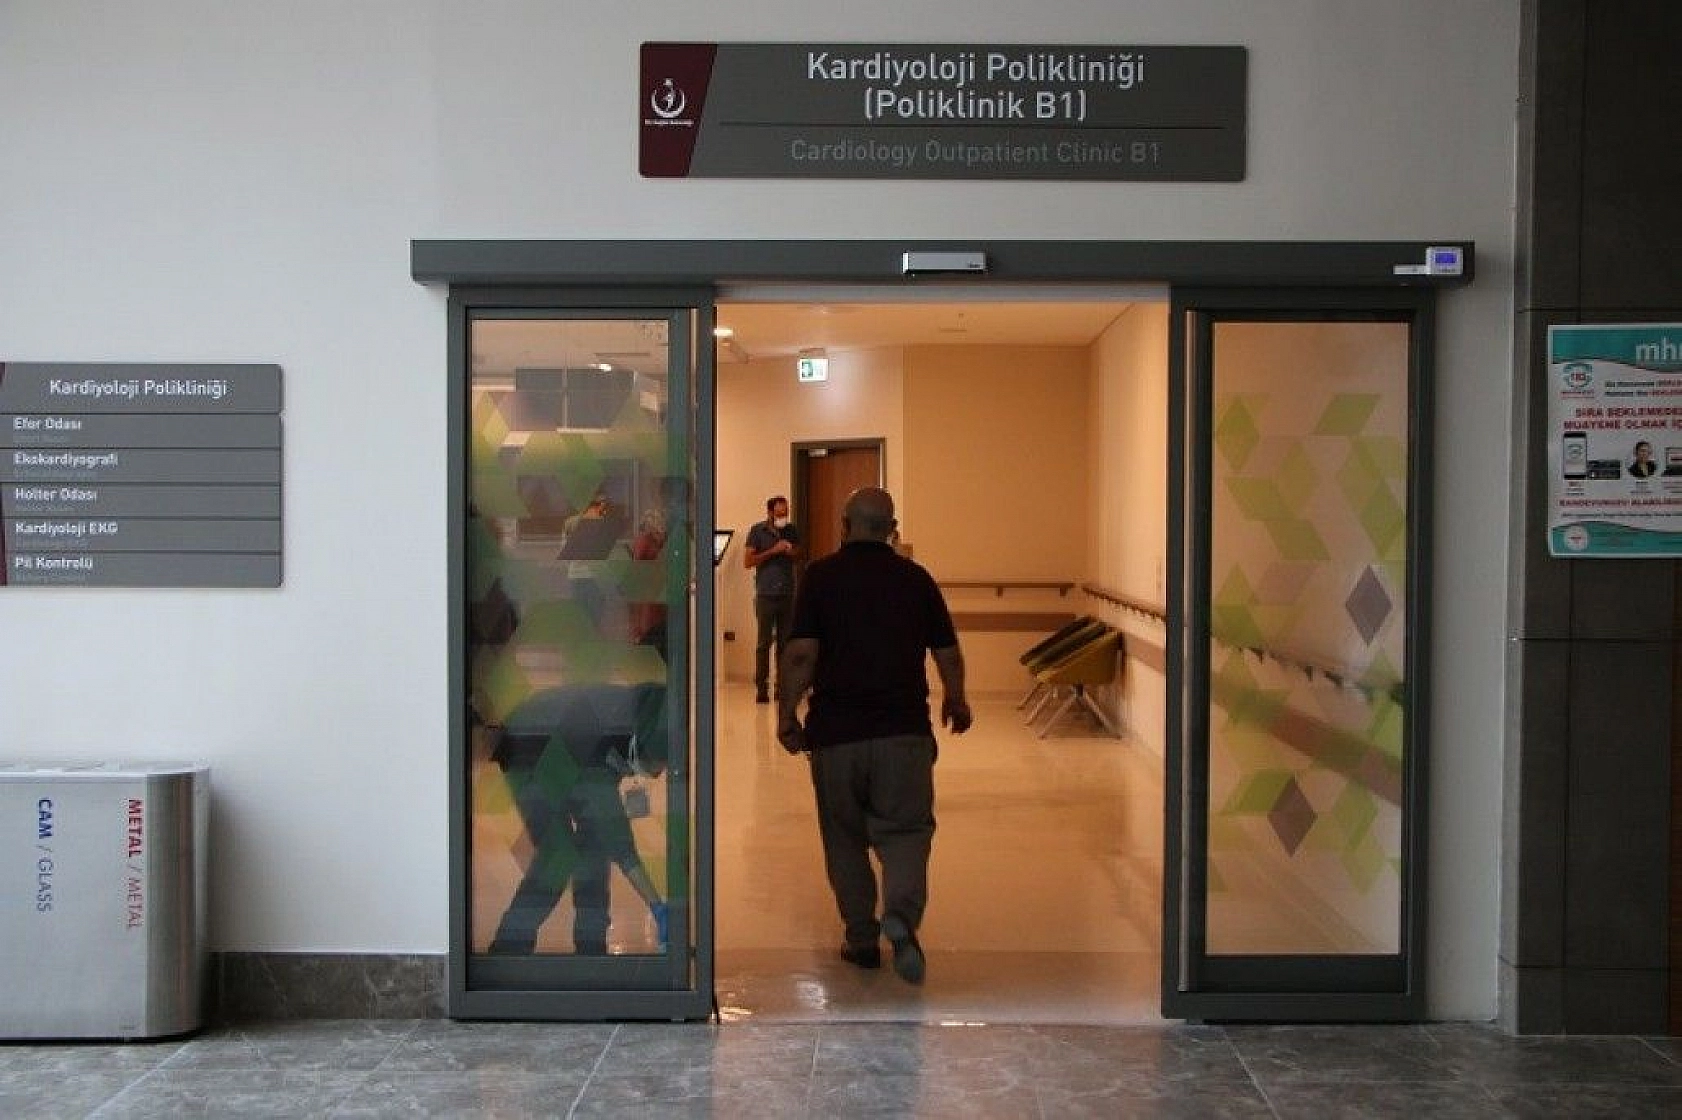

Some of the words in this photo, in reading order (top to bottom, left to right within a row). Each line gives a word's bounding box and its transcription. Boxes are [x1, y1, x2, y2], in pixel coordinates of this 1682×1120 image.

[807, 51, 976, 89] Kardiyoloji
[986, 53, 1145, 90] Polikliniği
[864, 86, 1025, 120] (Poliklinik
[1036, 89, 1087, 122] B1)
[790, 139, 917, 167] Cardiology
[925, 139, 1049, 167] Outpatient
[1057, 141, 1123, 164] Clinic
[1130, 142, 1160, 164] B1
[49, 380, 140, 399] Kardiyoloji
[144, 379, 228, 399] Polikliniği
[14, 417, 42, 430] Efor
[44, 417, 82, 430] Odası
[14, 487, 58, 501] Holter
[14, 522, 87, 537] Kardiyoloji
[89, 522, 119, 534] EKG
[37, 797, 53, 839] CAM
[127, 797, 143, 858] METAL
[36, 856, 54, 914] GLASS
[126, 878, 143, 931] METAL
